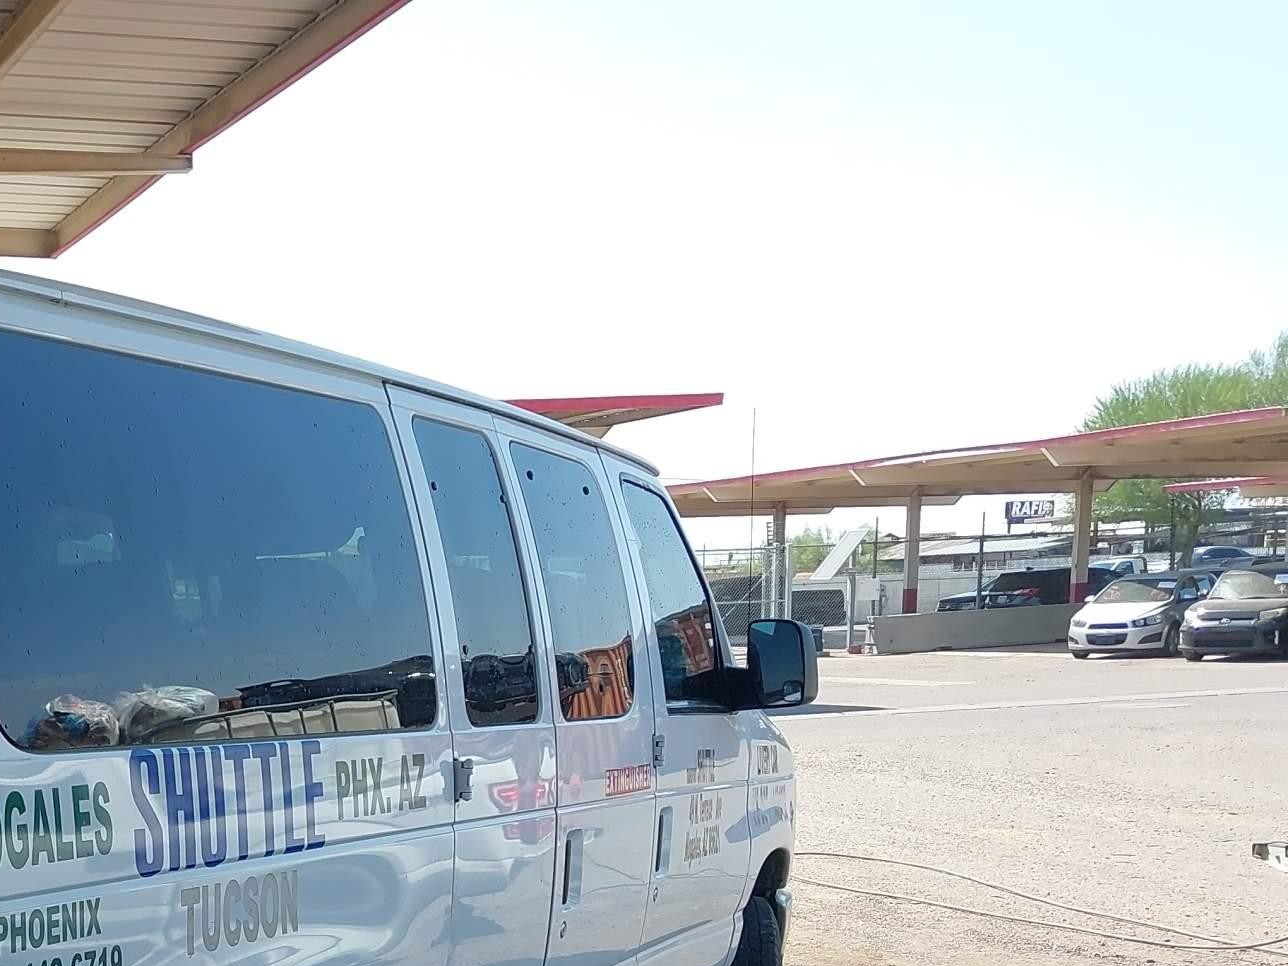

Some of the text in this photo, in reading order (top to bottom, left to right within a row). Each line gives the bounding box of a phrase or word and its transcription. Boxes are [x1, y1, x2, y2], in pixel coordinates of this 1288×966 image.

[129, 740, 326, 877] SHUTTLE
[399, 753, 427, 811] AZ
[606, 765, 651, 796] EXTINGUISHER
[180, 869, 299, 958] TUCSON
